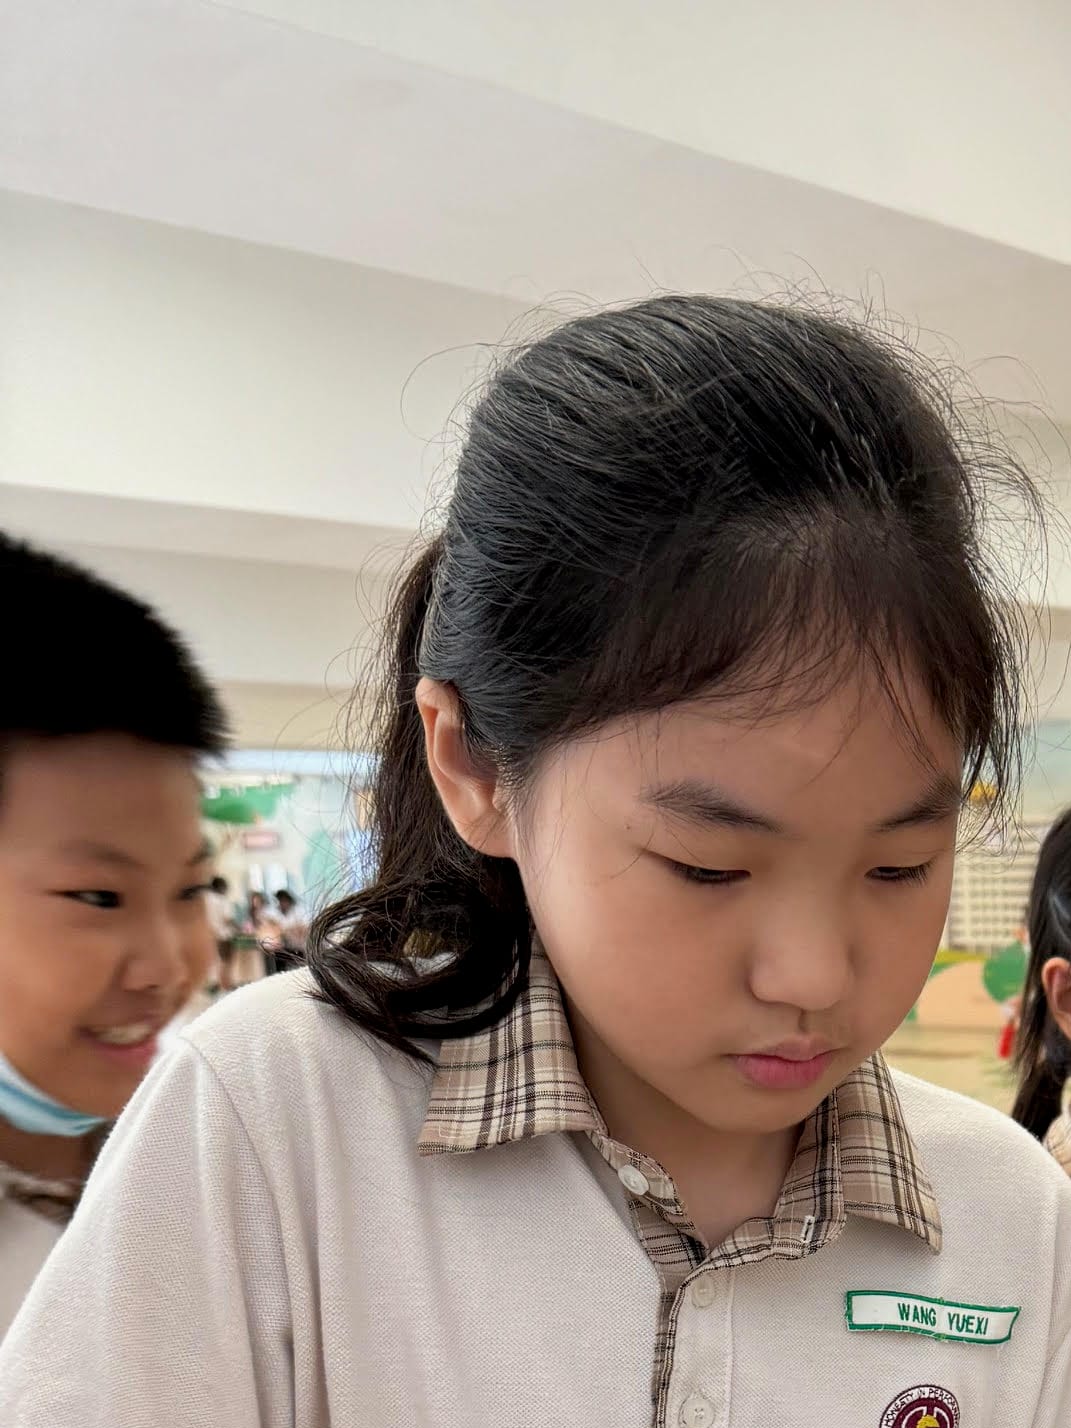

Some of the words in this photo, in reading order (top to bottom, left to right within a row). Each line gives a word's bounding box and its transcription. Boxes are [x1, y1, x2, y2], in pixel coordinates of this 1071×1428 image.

[897, 1303, 937, 1327] WANG
[947, 1312, 989, 1336] YUEXI
[884, 1392, 914, 1428] HONESTY
